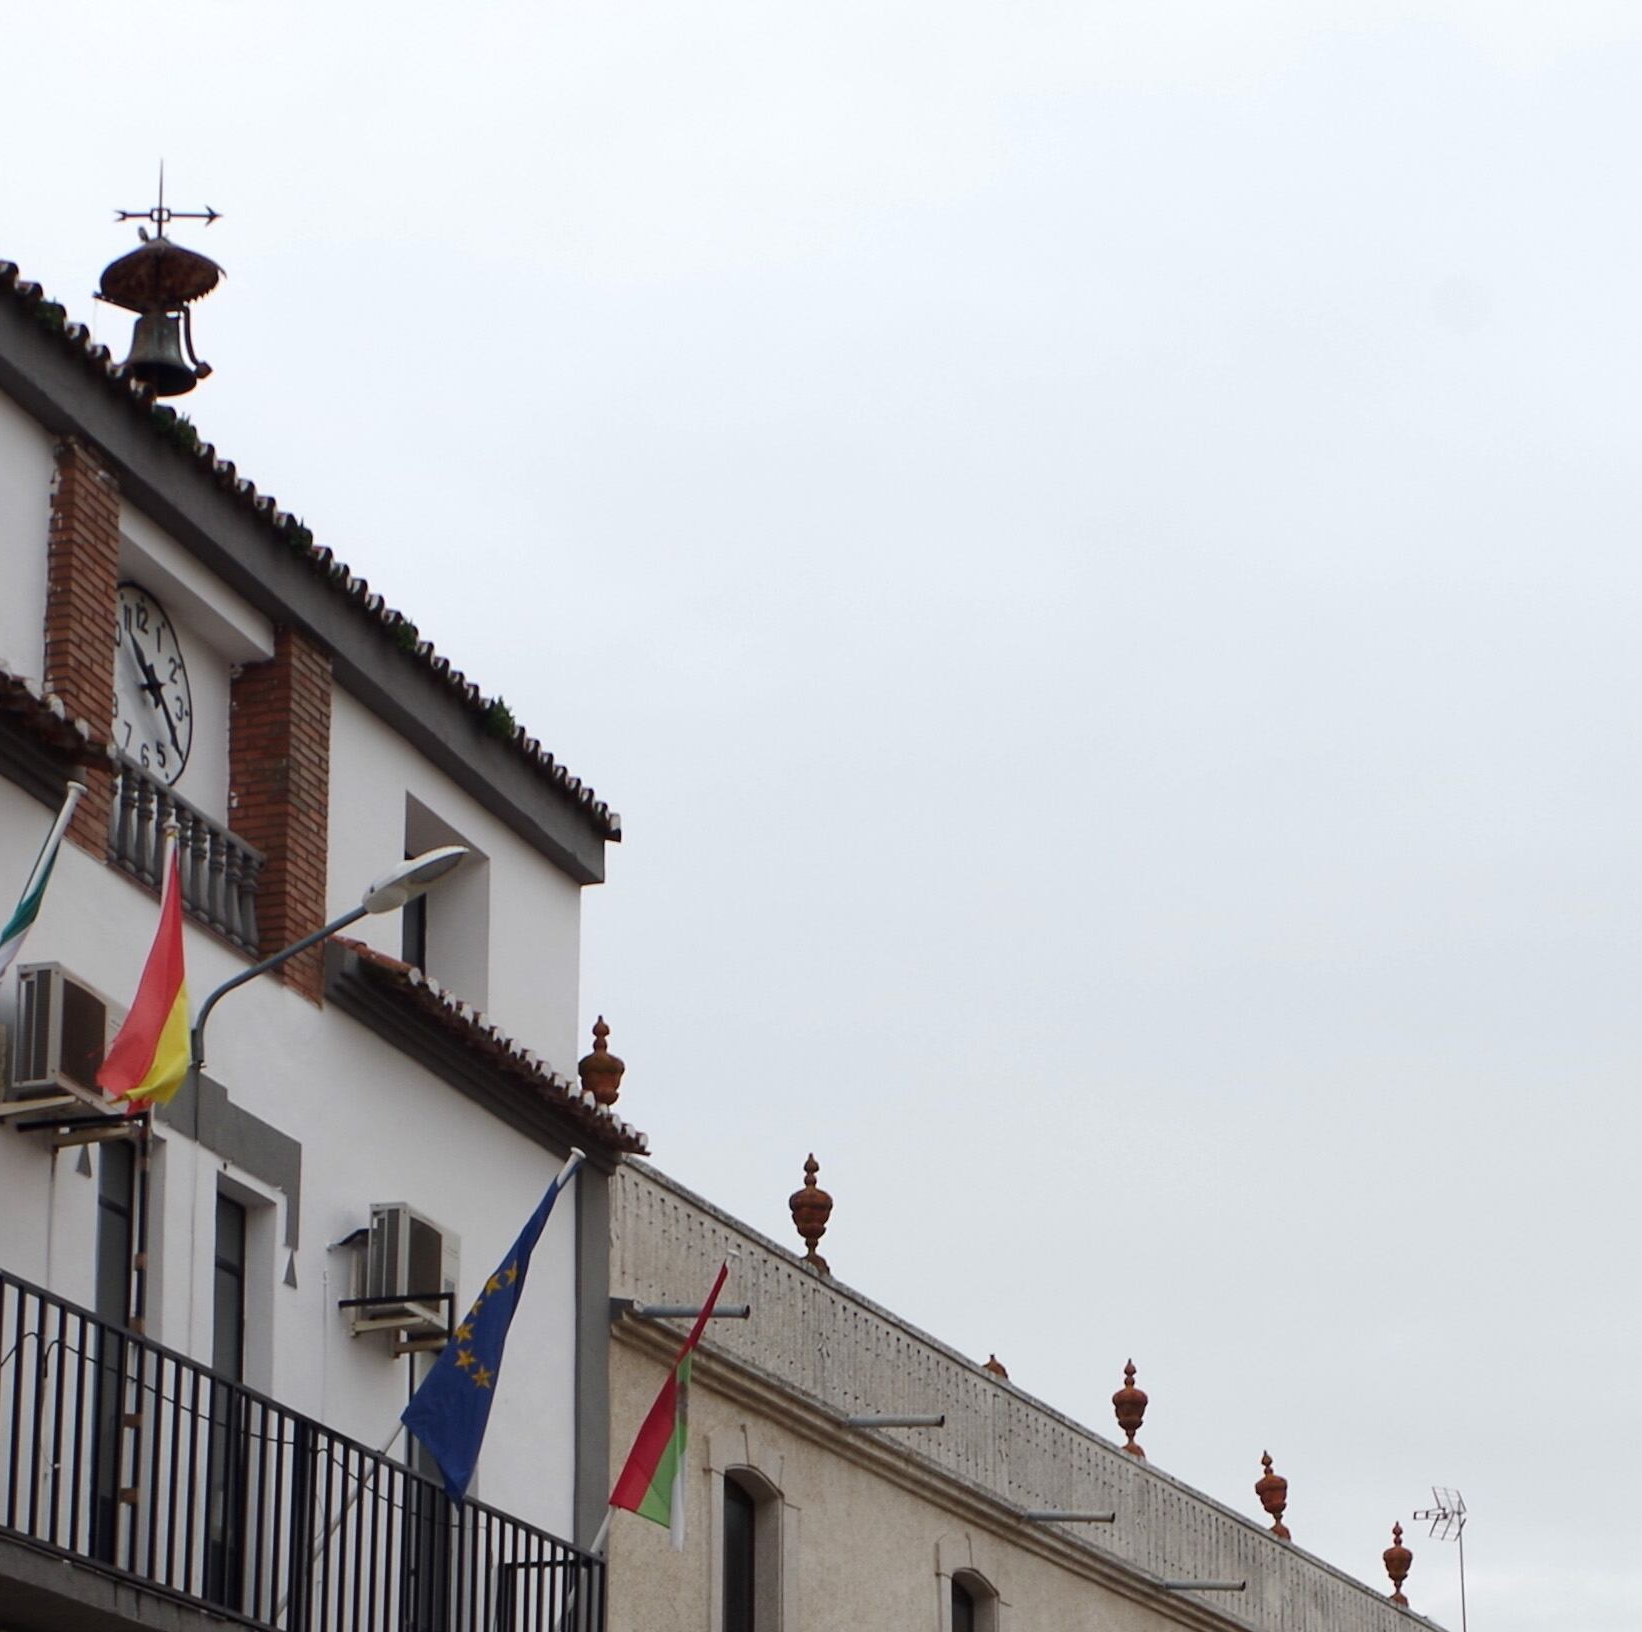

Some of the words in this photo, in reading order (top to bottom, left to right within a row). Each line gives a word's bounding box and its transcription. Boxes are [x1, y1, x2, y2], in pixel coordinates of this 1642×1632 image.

[136, 602, 148, 634] 12
[156, 626, 162, 653] 1
[169, 656, 178, 684] 2
[175, 696, 184, 722] 3
[123, 721, 132, 749] 7
[140, 742, 150, 769] 6
[156, 741, 166, 769] 5
